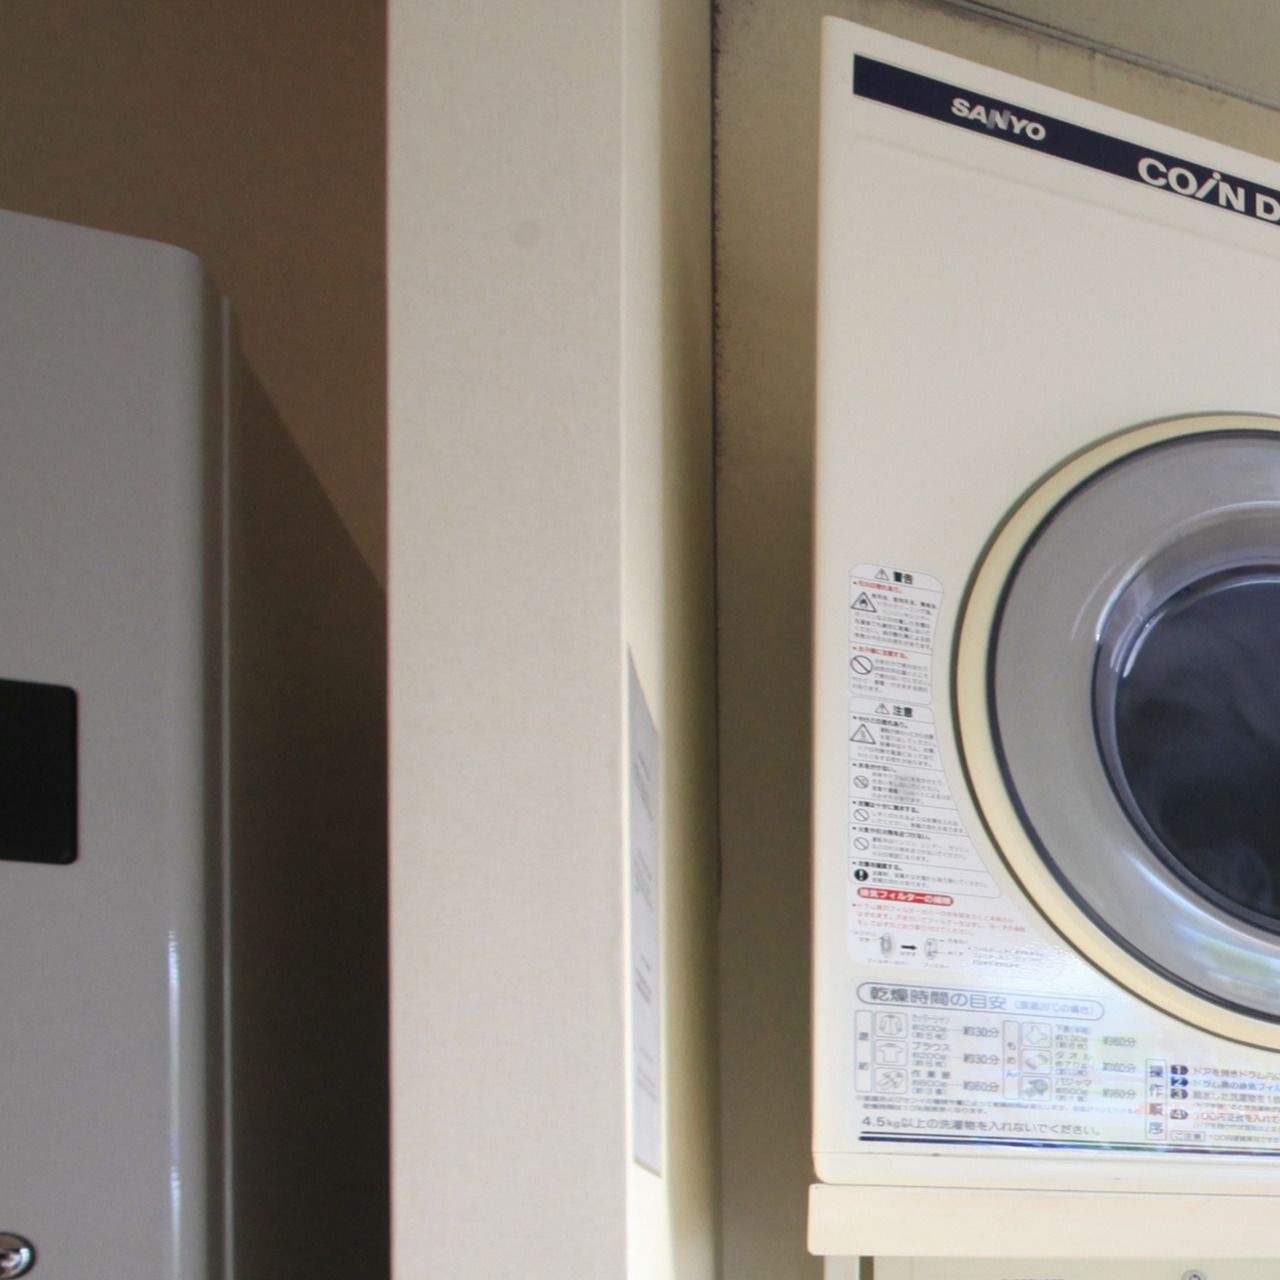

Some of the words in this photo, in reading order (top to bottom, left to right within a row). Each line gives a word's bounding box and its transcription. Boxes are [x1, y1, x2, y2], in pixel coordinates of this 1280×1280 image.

[951, 97, 1047, 142] SANYO
[869, 986, 1007, 1011] 乾燥時間の目安
